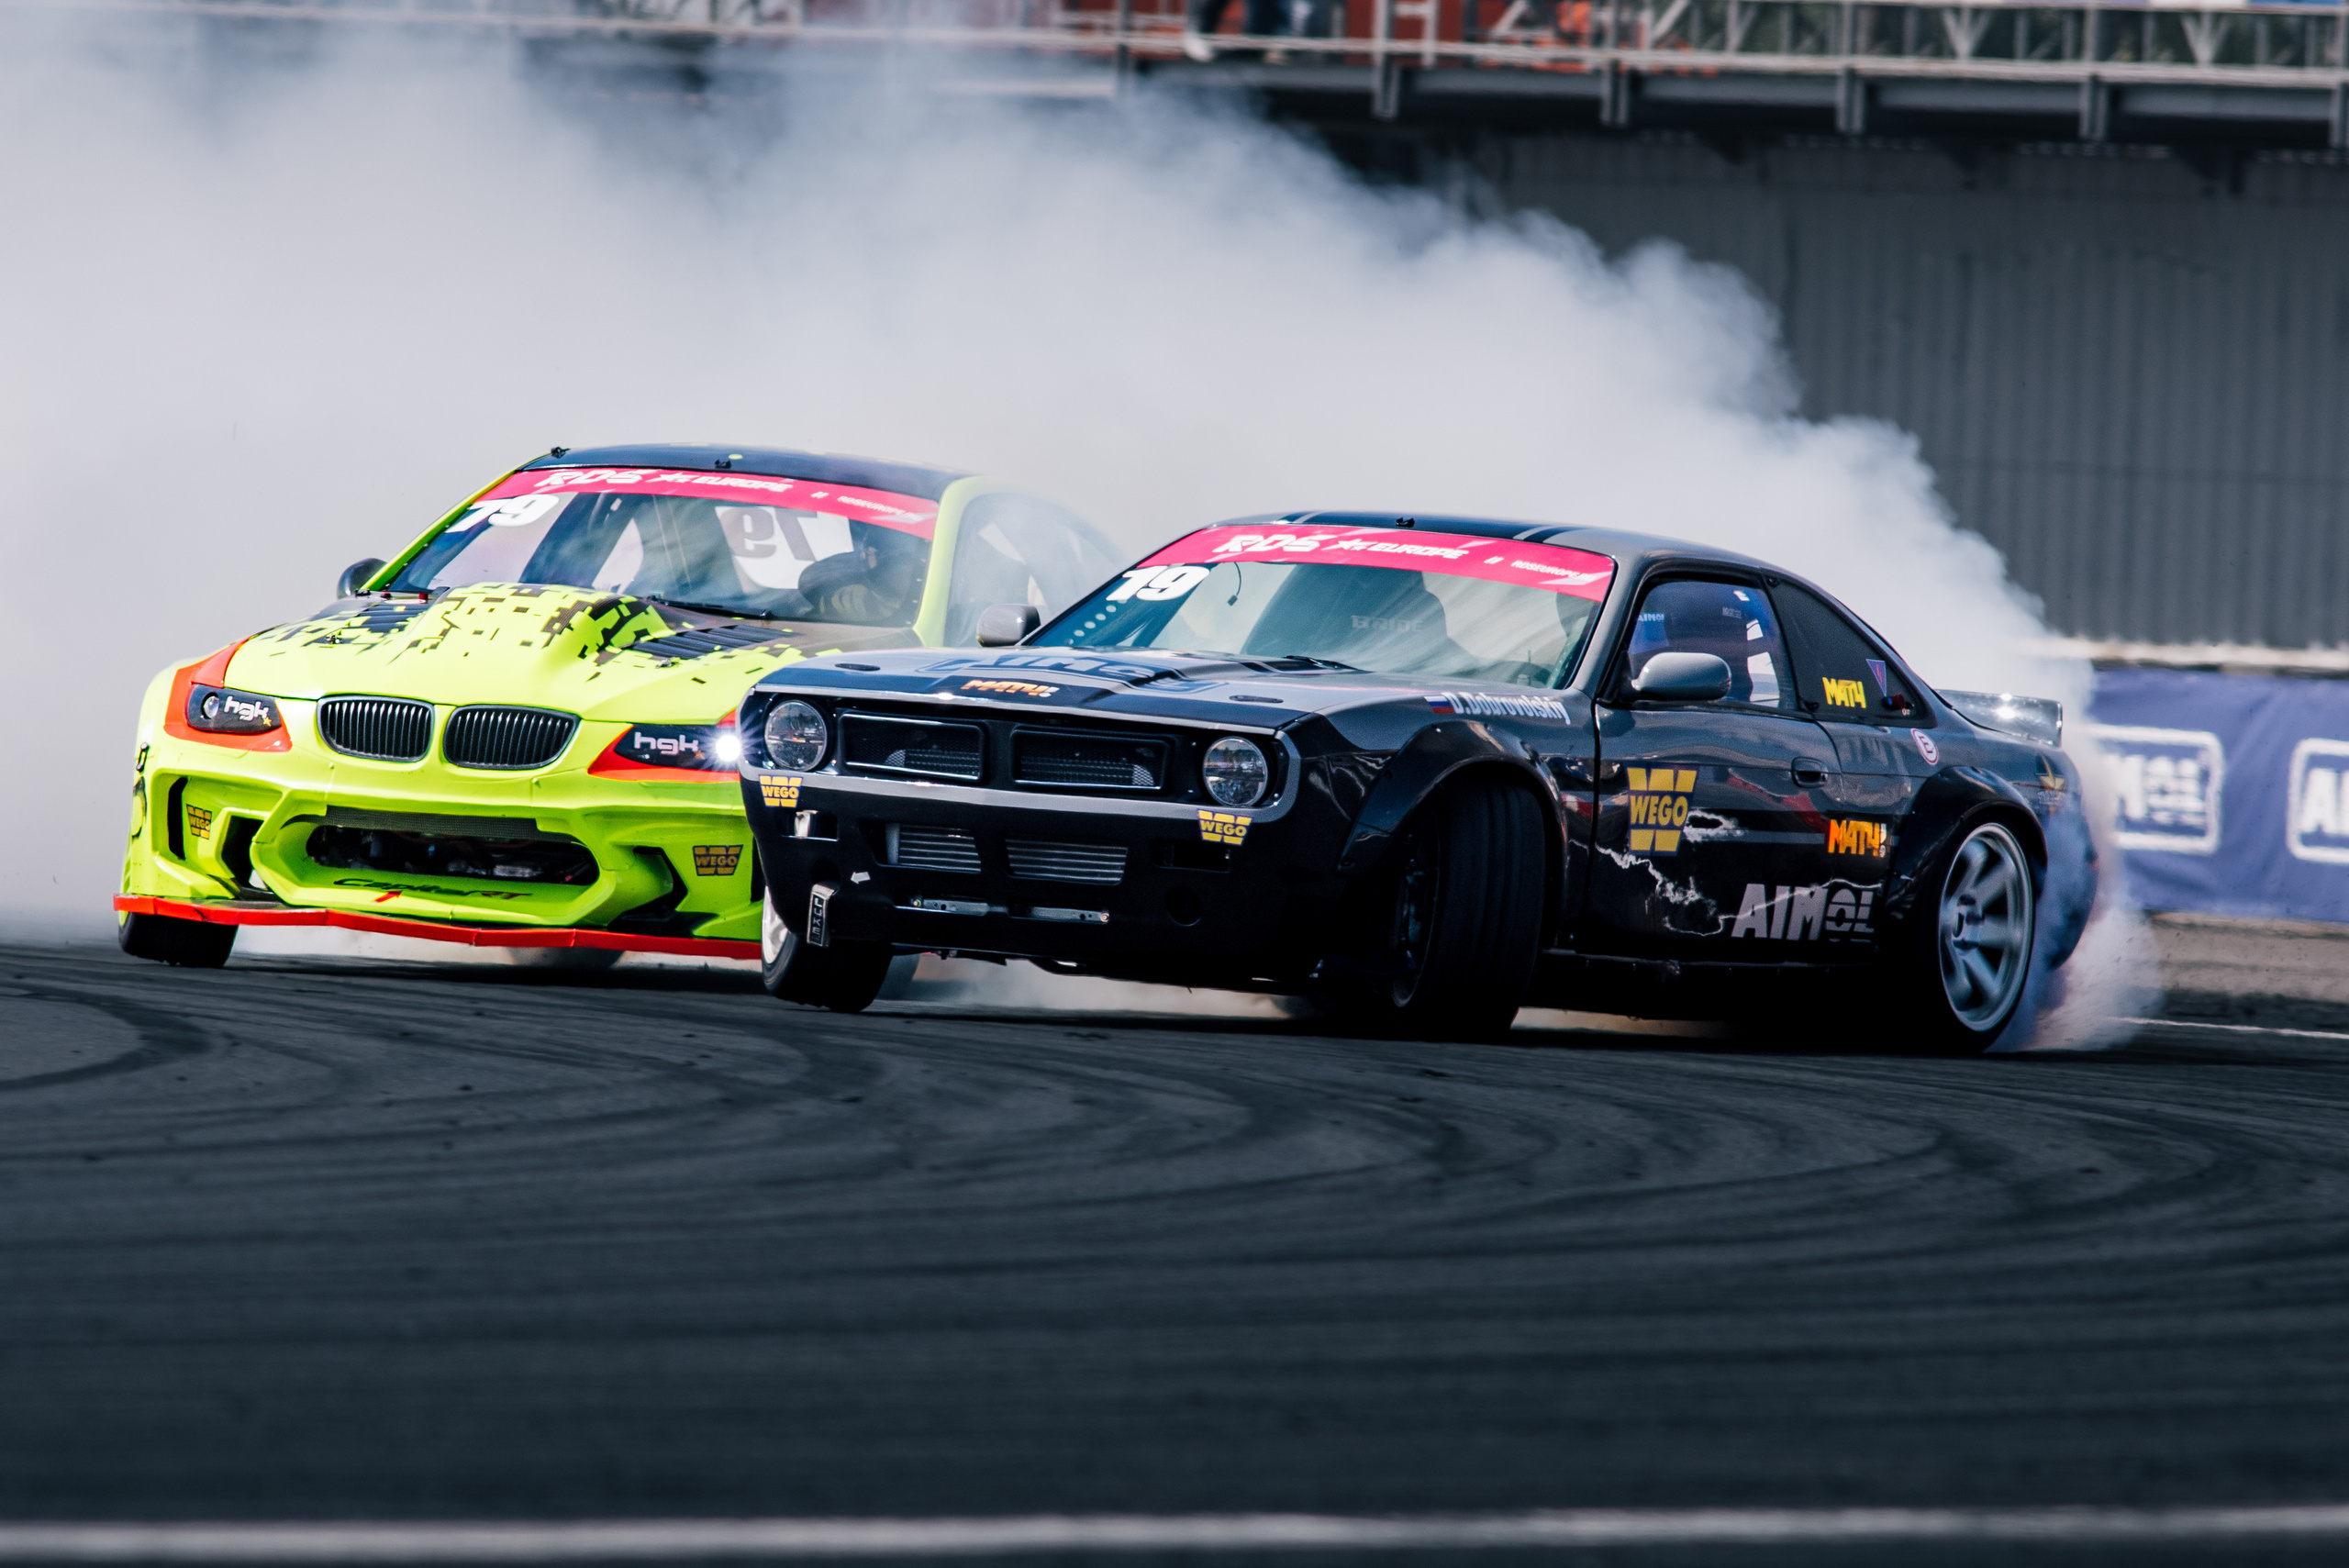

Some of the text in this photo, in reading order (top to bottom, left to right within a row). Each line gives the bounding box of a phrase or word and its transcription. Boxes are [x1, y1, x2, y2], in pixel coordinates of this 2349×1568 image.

[534, 469, 658, 487] RDS
[688, 475, 794, 494] EUROPE
[1212, 534, 1338, 552] RDS
[1366, 542, 1470, 560] EUROPE
[1106, 565, 1209, 602] 19
[224, 695, 269, 721] hgk
[634, 731, 699, 756] hgk
[761, 785, 799, 799] WEGO
[189, 815, 211, 831] WEGO
[1629, 795, 1689, 828] WEGO
[1199, 819, 1248, 837] WEGO
[695, 855, 738, 867] WEGO
[812, 897, 823, 936] LUKE
